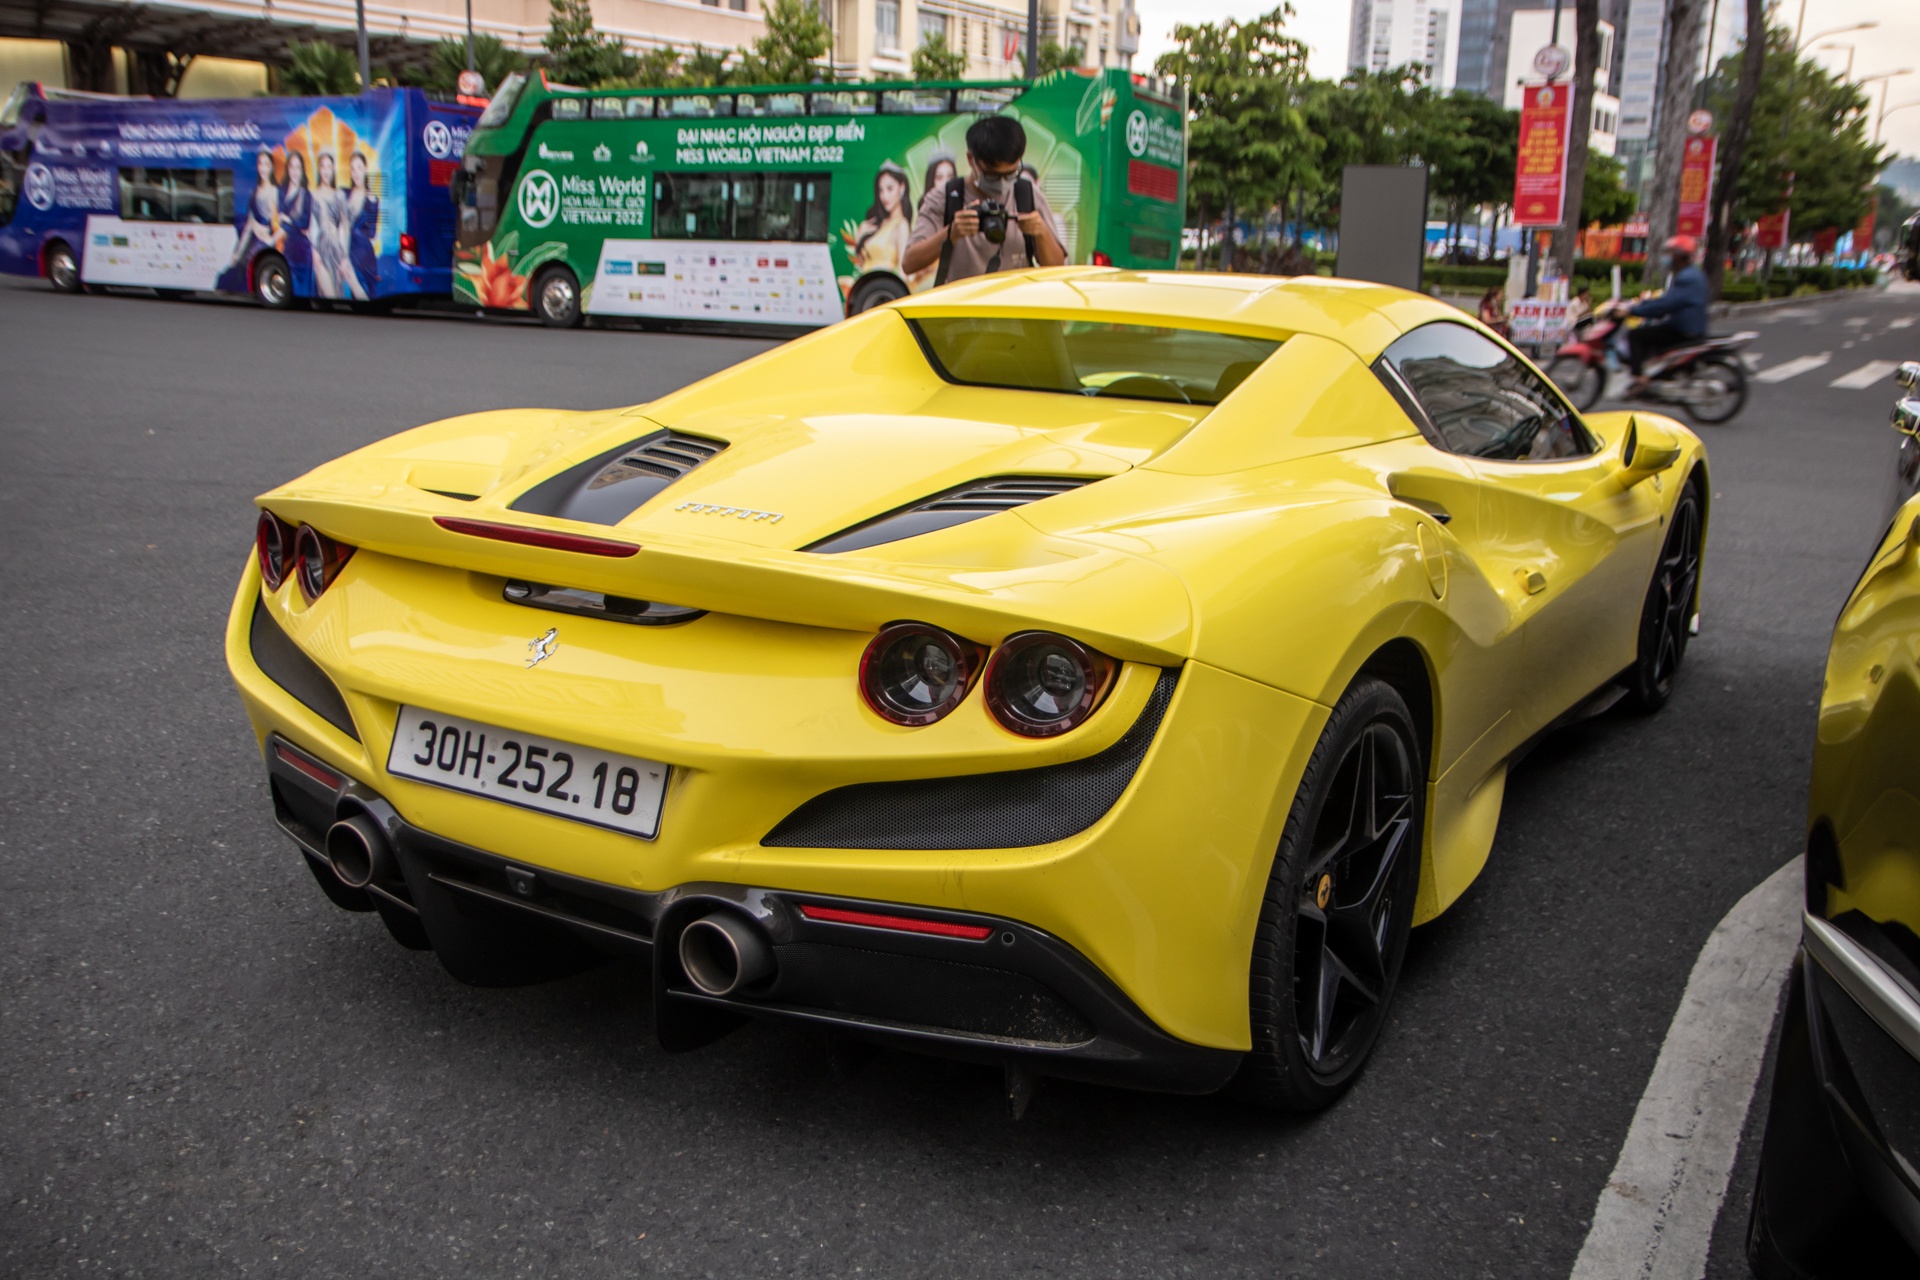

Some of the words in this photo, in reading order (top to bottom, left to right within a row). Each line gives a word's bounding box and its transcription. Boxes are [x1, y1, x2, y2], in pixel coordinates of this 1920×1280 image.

[677, 128, 699, 148] ĐẠI
[700, 127, 736, 148] NHẠC
[738, 123, 761, 147] HỘI
[676, 148, 704, 164] MISS
[706, 147, 752, 164] WORLD
[754, 146, 810, 163] VIETNAM
[812, 146, 844, 162] 2022
[561, 174, 596, 194] Miss
[599, 175, 646, 195] World
[561, 211, 612, 225] VIETNAM
[615, 211, 644, 225] 2022
[675, 501, 784, 524] Ferrari
[414, 720, 640, 815] 30H-252.18
